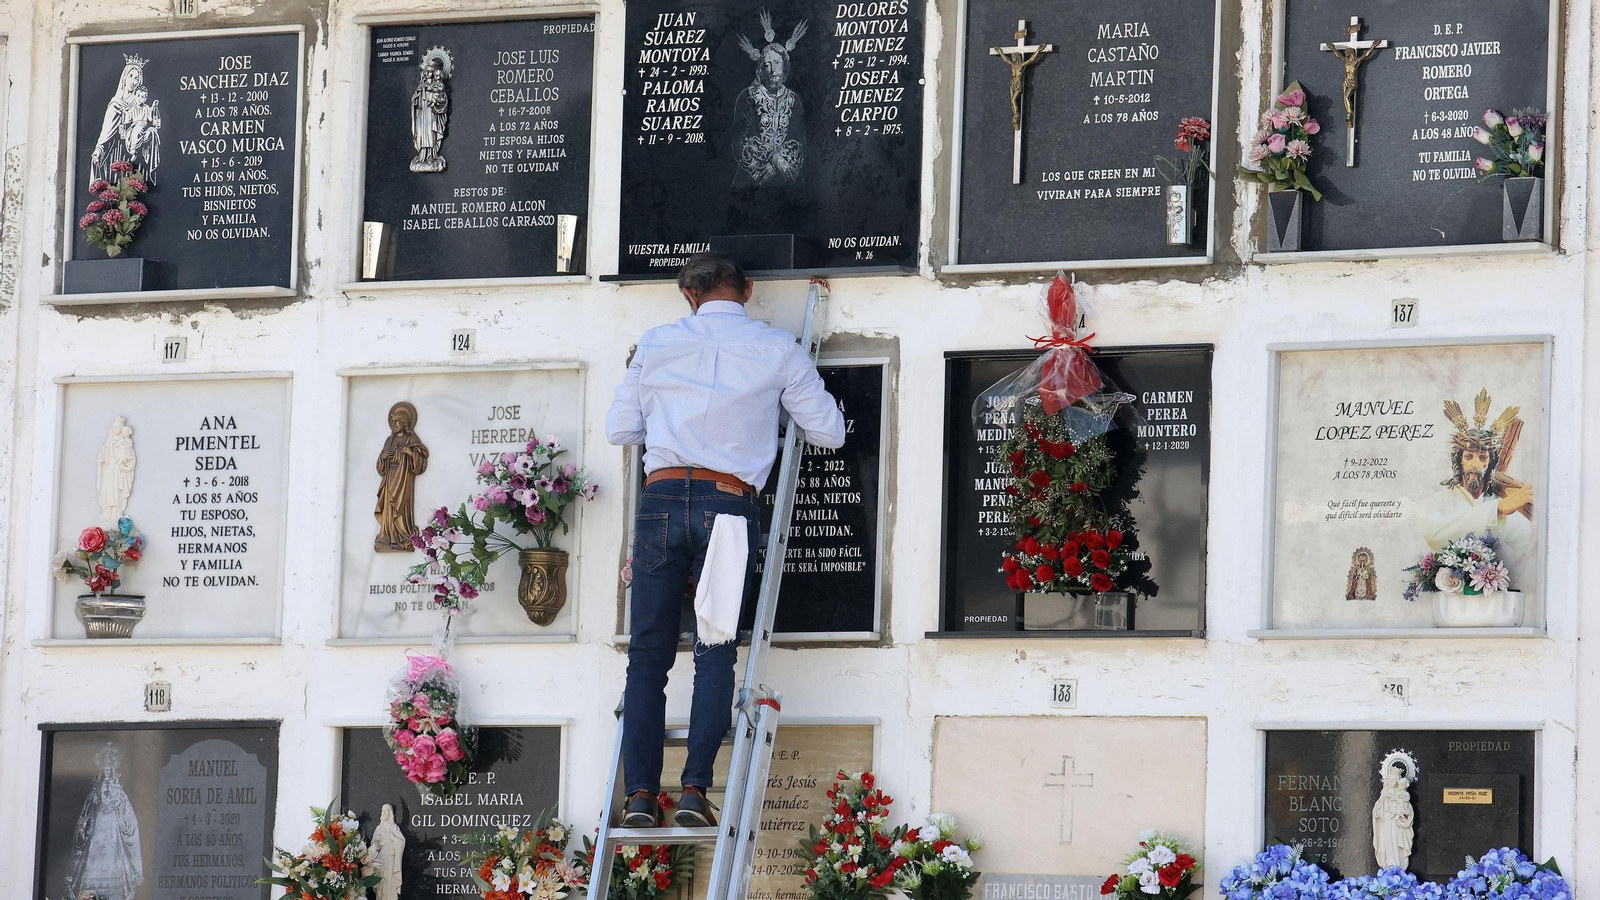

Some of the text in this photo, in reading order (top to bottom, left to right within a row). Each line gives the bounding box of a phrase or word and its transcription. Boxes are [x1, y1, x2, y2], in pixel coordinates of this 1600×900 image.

[179, 0, 194, 14] 116
[835, 1, 909, 19] DOLORES
[543, 21, 596, 35] PROPIEDAD
[654, 12, 696, 31] JUAN
[834, 18, 909, 37] MONTOYA
[643, 29, 706, 46] SUAREZ
[1097, 22, 1150, 40] MARIA
[836, 37, 906, 57] JIMENEZ
[1087, 43, 1160, 64] CASTAÑO
[1394, 40, 1501, 61] FRANCISCO JAVIER
[218, 56, 252, 71] JOSE
[493, 49, 560, 67] JOSE LUIS
[638, 47, 711, 64] MONTOYA
[496, 68, 554, 85] ROMERO
[841, 70, 900, 89] JOSEFA
[1089, 69, 1155, 88] MARTIN
[1422, 64, 1472, 80] ROMERO
[179, 71, 289, 91] SANCHEZ DIAZ
[642, 80, 705, 96] PALOMA
[490, 87, 559, 104] CEBALLOS
[835, 87, 905, 108] JIMENEZ
[1103, 93, 1151, 106] 10-5-2012
[1424, 86, 1469, 101] ORTEGA
[195, 103, 272, 119] A LOS 78 AÑOS.
[508, 106, 552, 116] 16-7-2008
[645, 97, 701, 113] RAMOS
[840, 106, 898, 123] CARPIO
[1083, 109, 1159, 124] A LOS 78 AÑOS
[1431, 110, 1469, 123] 6-3-2020
[200, 119, 265, 136] CARMEN
[640, 114, 703, 132] SUAREZ
[180, 136, 285, 155] VASCO MURGA
[483, 134, 565, 146] TU ESPOSA HIJOS
[1418, 150, 1472, 164] TU FAMILIA
[1041, 167, 1156, 183] LOS QUE CREEN EN MI
[1412, 170, 1427, 182] NO
[1428, 169, 1441, 181] TE
[182, 184, 279, 198] TUS HIJOS, NIETOS,
[453, 186, 507, 198] RESTOS DE:
[1037, 185, 1161, 201] VIVIRAN PARA SIEMPRE
[203, 199, 256, 212] BISNIETOS
[410, 200, 546, 215] MANUEL ROMERO ALCON
[402, 214, 555, 231] ISABEL CEBALLOS CARRASCO
[187, 226, 271, 241] NO OS OLVIDAN.
[628, 242, 711, 256] VUESTRA FAMILIA
[828, 235, 902, 249] NO OS OLVIDAN.
[1393, 304, 1415, 324] 137
[451, 333, 470, 351] 124
[164, 342, 181, 360] 117
[1142, 390, 1194, 405] CARMEN
[487, 405, 521, 421] JOSE
[1146, 408, 1188, 421] PEREA
[1335, 400, 1415, 418] MANUEL
[199, 415, 238, 431] ANA
[985, 410, 1016, 425] PEÑA
[471, 427, 537, 445] HERRERA
[1136, 423, 1197, 439] MONTERO
[1314, 424, 1434, 442] LOPEZ PEREZ
[174, 435, 261, 452] PIMENTEL
[1152, 440, 1190, 450] 12-1-2020
[194, 456, 238, 472] SEDA
[1350, 457, 1388, 467] 9-12-2022
[809, 474, 851, 489] 88 AÑOS
[172, 490, 258, 505] A LOS 85 AÑOS
[823, 492, 861, 505] NIETOS
[1327, 498, 1396, 510] Qué fácil fue quererte
[180, 509, 249, 522] TU ESPOSO,
[795, 509, 839, 522] FAMILIA
[1325, 511, 1337, 521] qué
[1359, 511, 1372, 519] será
[1373, 510, 1402, 519] olvidarte
[170, 526, 256, 539] HIJOS, NIETAS,
[804, 524, 854, 538] OLVIDAN.
[177, 542, 248, 554] HERMANOS
[805, 544, 863, 558] HA SIDO FÁCIL
[798, 559, 867, 573] SERÁ IMPOSIBLE"
[162, 575, 259, 588] NO TE OLVIDAN.
[369, 584, 397, 595] HIJOS
[964, 614, 1008, 623] PROPIEDAD
[149, 689, 165, 706] 118
[1052, 683, 1072, 703] 133
[1448, 742, 1511, 751] PROPIEDAD
[188, 759, 239, 777] MANUEL
[785, 773, 817, 790] Jesús
[166, 787, 257, 805] SORIA DE AMIL
[420, 793, 524, 806] ISABEL MARIA
[411, 814, 531, 827] GIL DOMINGUEZ
[1298, 817, 1339, 833] SOTO
[173, 854, 190, 867] TUS
[158, 875, 208, 889] HERMANOS
[985, 883, 1050, 900] FRANCISCO
